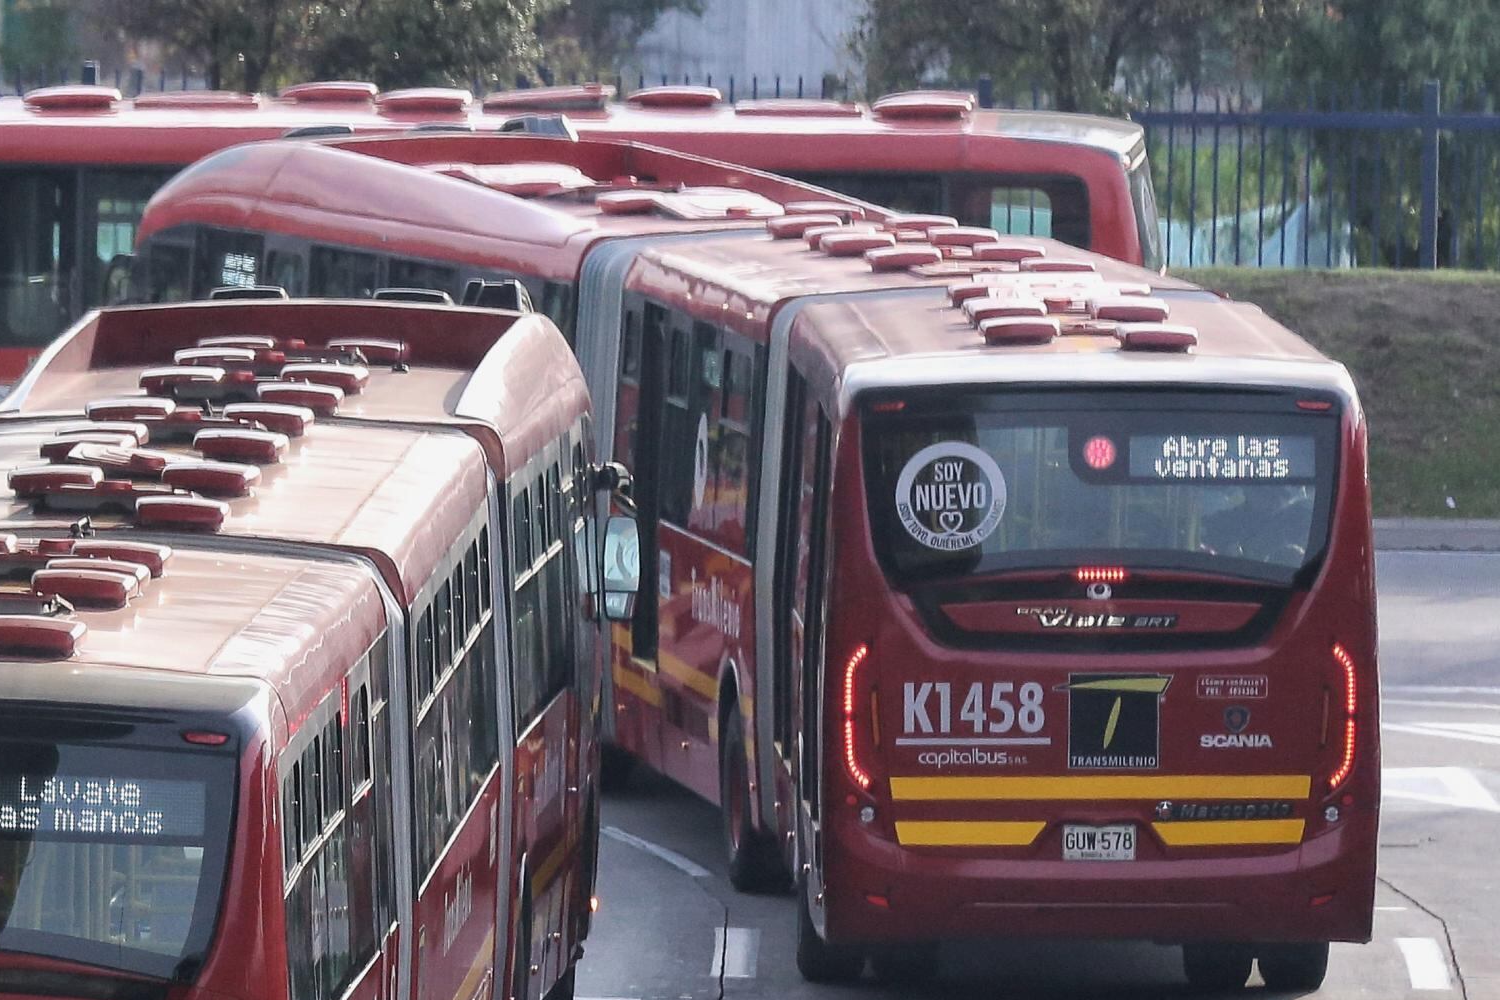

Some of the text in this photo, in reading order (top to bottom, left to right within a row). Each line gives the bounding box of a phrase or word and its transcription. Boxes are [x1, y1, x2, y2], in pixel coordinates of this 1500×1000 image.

[1163, 435, 1280, 458] Abre las
[934, 462, 963, 482] SOY
[1155, 455, 1289, 478] ventanas
[915, 482, 987, 512] NUEVO
[903, 681, 1046, 734] K1458
[1200, 734, 1273, 748] SCANIA
[918, 747, 1008, 769] capitalbus
[1071, 755, 1156, 767] TRANSMILENIO
[53, 807, 164, 835] manos
